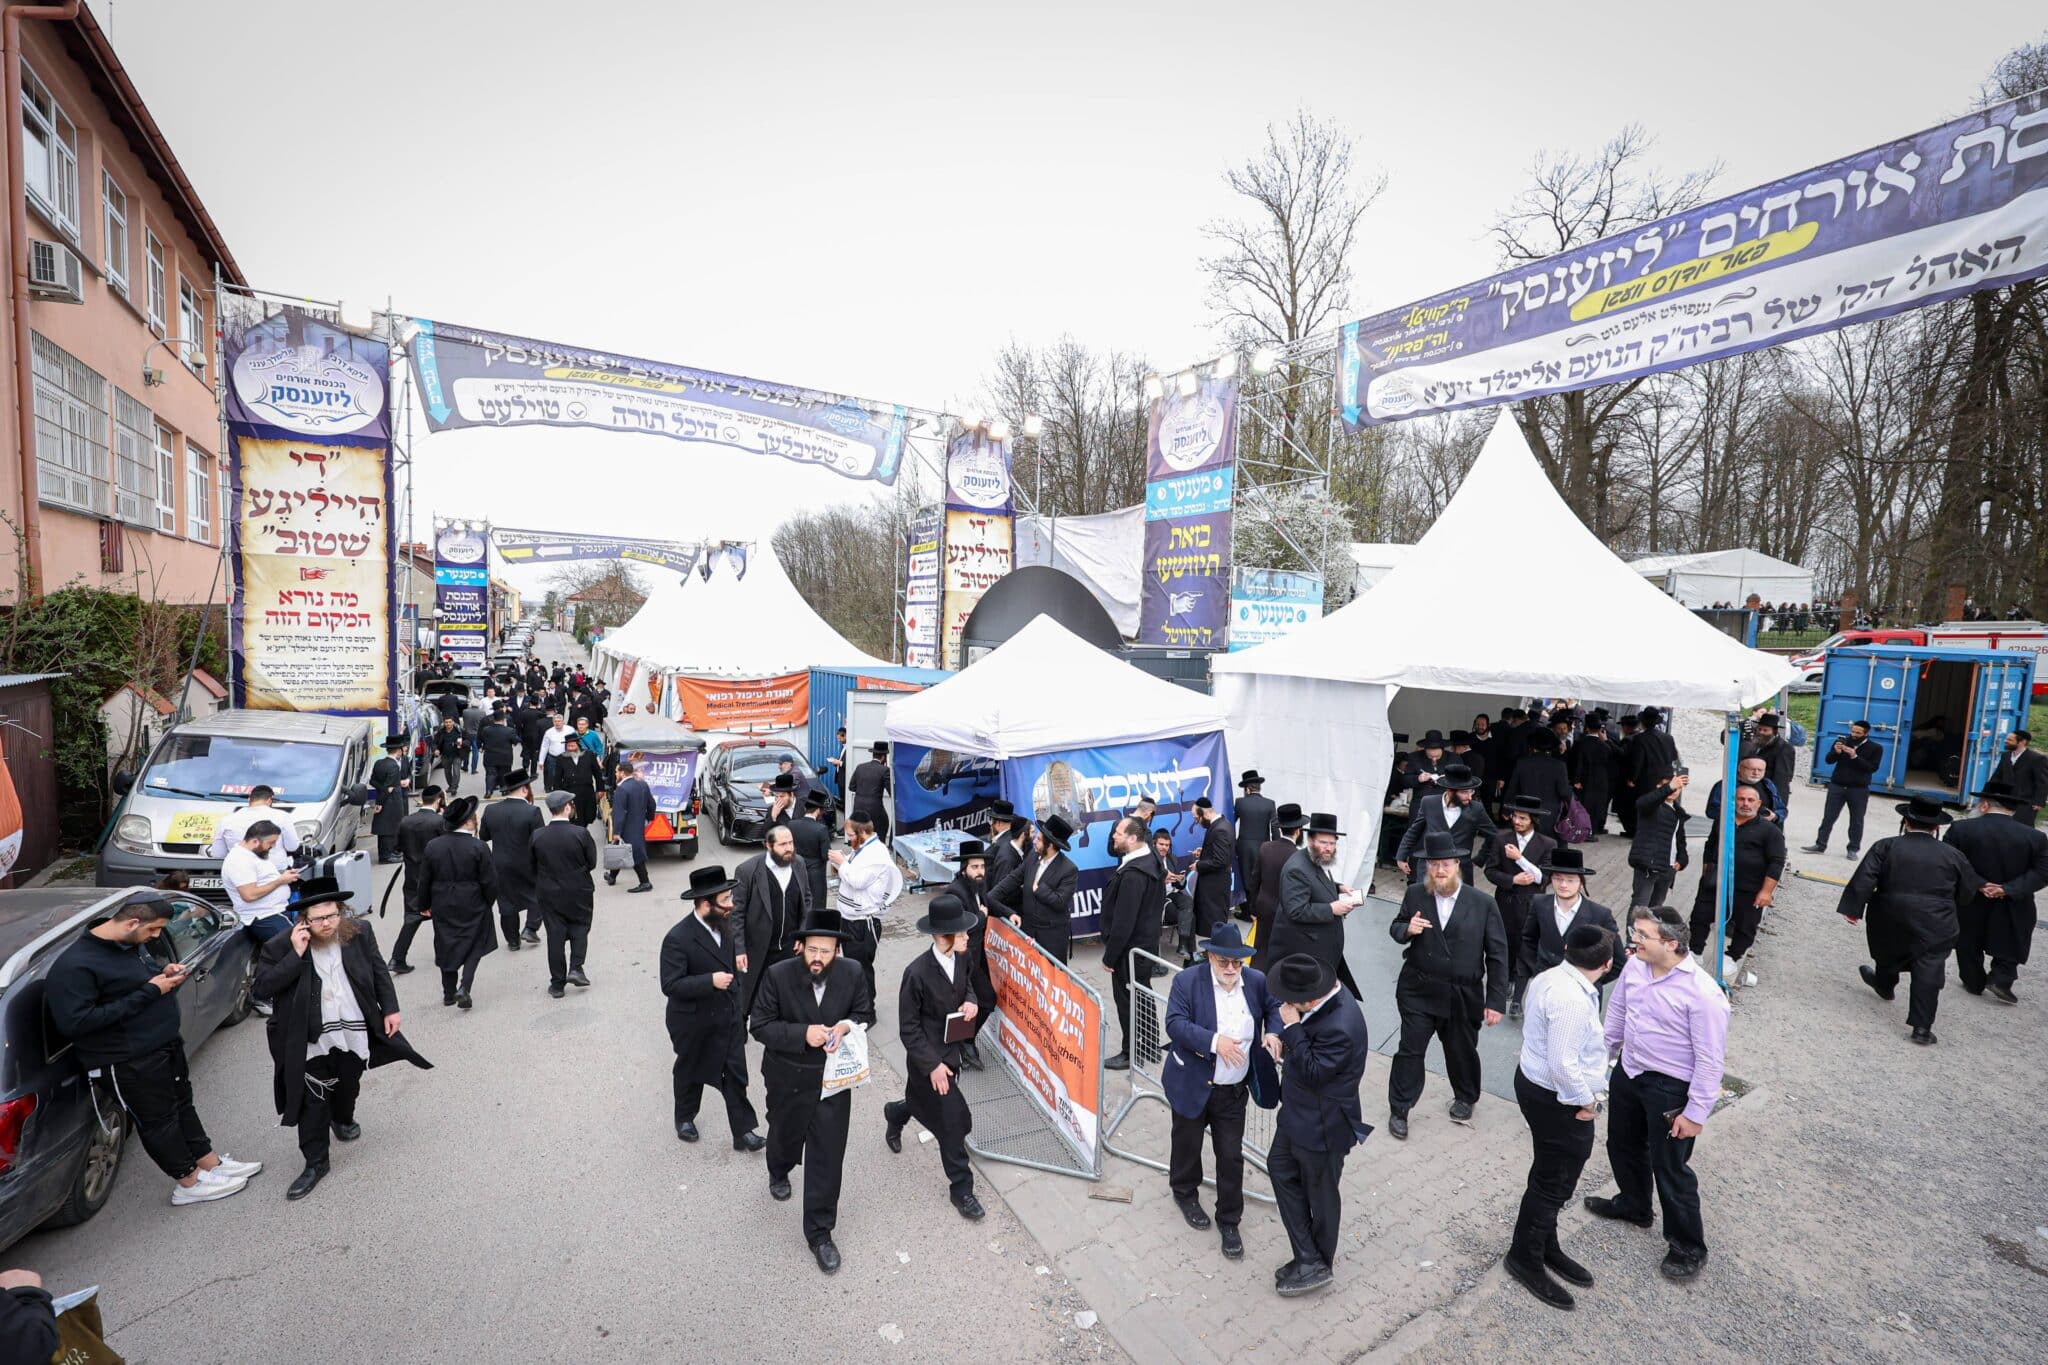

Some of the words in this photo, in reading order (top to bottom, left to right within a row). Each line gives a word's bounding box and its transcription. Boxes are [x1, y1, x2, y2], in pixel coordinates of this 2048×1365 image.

[1697, 150, 1922, 259] אורחים
[1906, 235, 2026, 292] האהל
[1763, 294, 1822, 331] של
[276, 373, 311, 384] אורחים
[314, 378, 346, 389] הכנסת
[1479, 360, 1563, 396] אלימלך
[271, 384, 351, 408] ליזענסק
[478, 395, 560, 424] טוילעט
[612, 405, 665, 430] תורה
[671, 411, 718, 439] היכל
[757, 431, 839, 464] שטיבלעך
[1167, 475, 1211, 502] מענער
[278, 590, 323, 606] נורא
[330, 591, 358, 607] מה
[444, 602, 480, 611] אורחים
[446, 591, 479, 600] הכנסת
[265, 610, 301, 625] הזה
[307, 611, 370, 633] המקום
[1251, 604, 1294, 626] מענער
[706, 701, 734, 709] Medical
